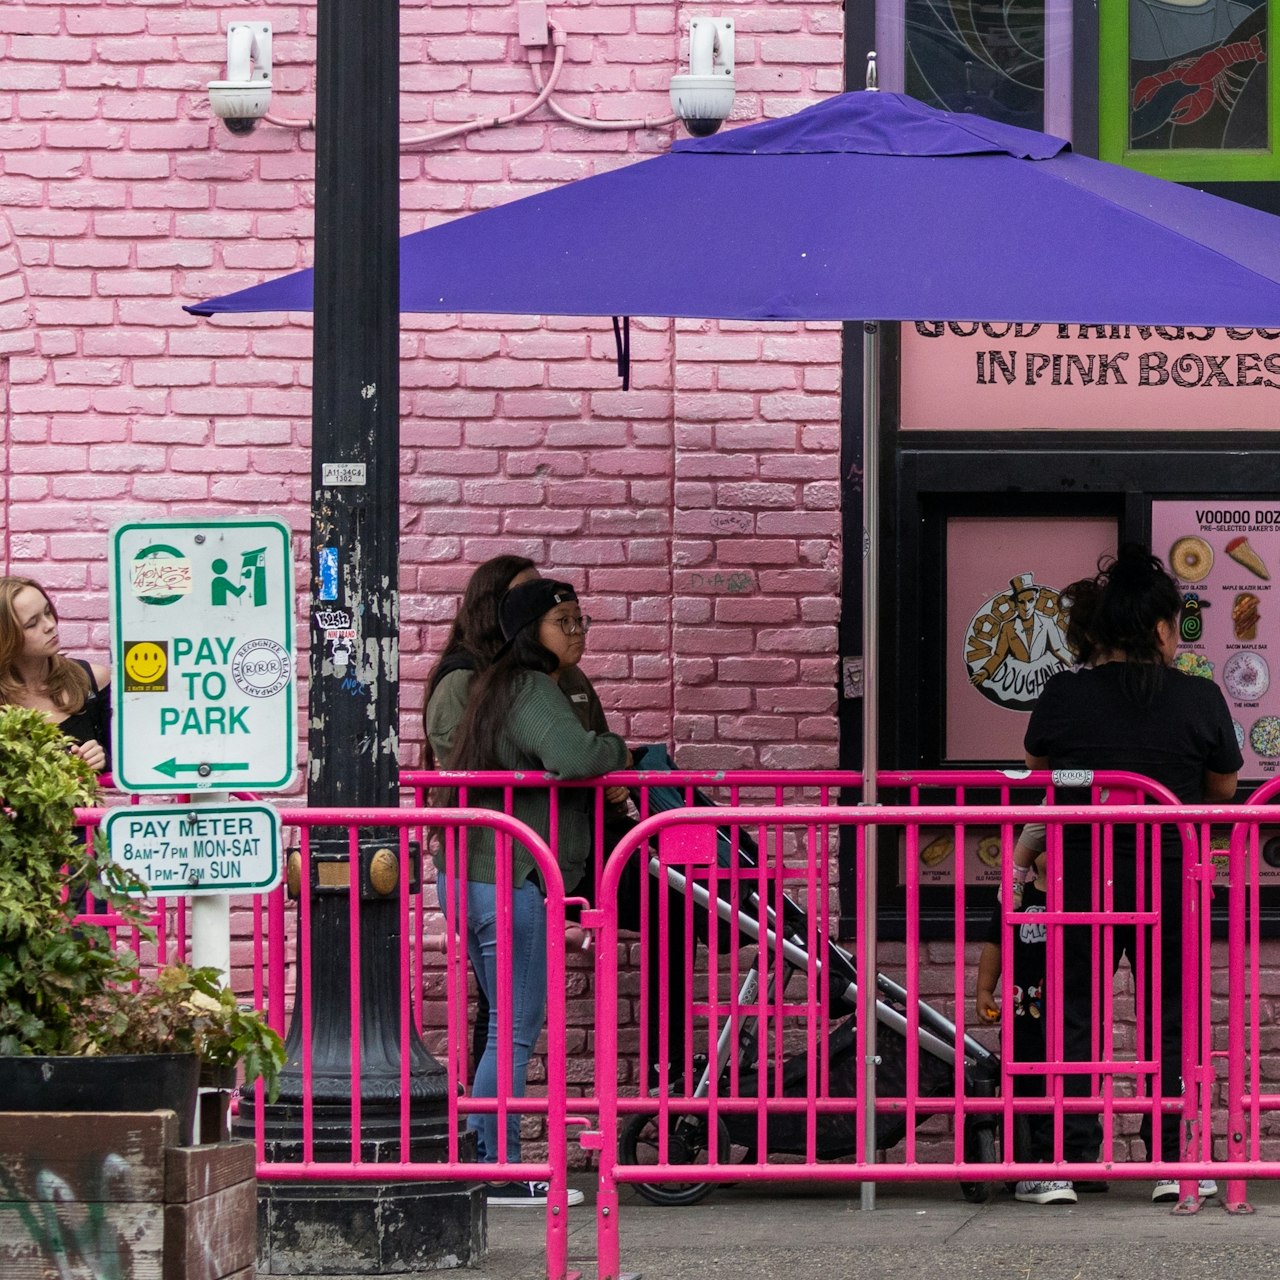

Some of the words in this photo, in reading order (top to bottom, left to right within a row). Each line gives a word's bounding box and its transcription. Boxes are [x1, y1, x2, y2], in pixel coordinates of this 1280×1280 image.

[975, 351, 1016, 385] IN
[1025, 353, 1129, 386] PINK
[1196, 511, 1250, 524] VOODOO
[174, 637, 236, 666] PAY
[238, 641, 282, 657] RECOGNIZE
[234, 661, 243, 683] REAL
[281, 657, 289, 678] REAL
[181, 671, 227, 701] TO
[244, 682, 282, 696] COMPANY
[160, 706, 251, 735] PARK
[130, 821, 171, 838] PAY
[179, 818, 253, 837] METER
[124, 842, 188, 861] 8AM-7PM
[194, 838, 260, 858] MON-SAT
[144, 863, 205, 881] 1PM-7PM
[210, 861, 241, 878] SUN
